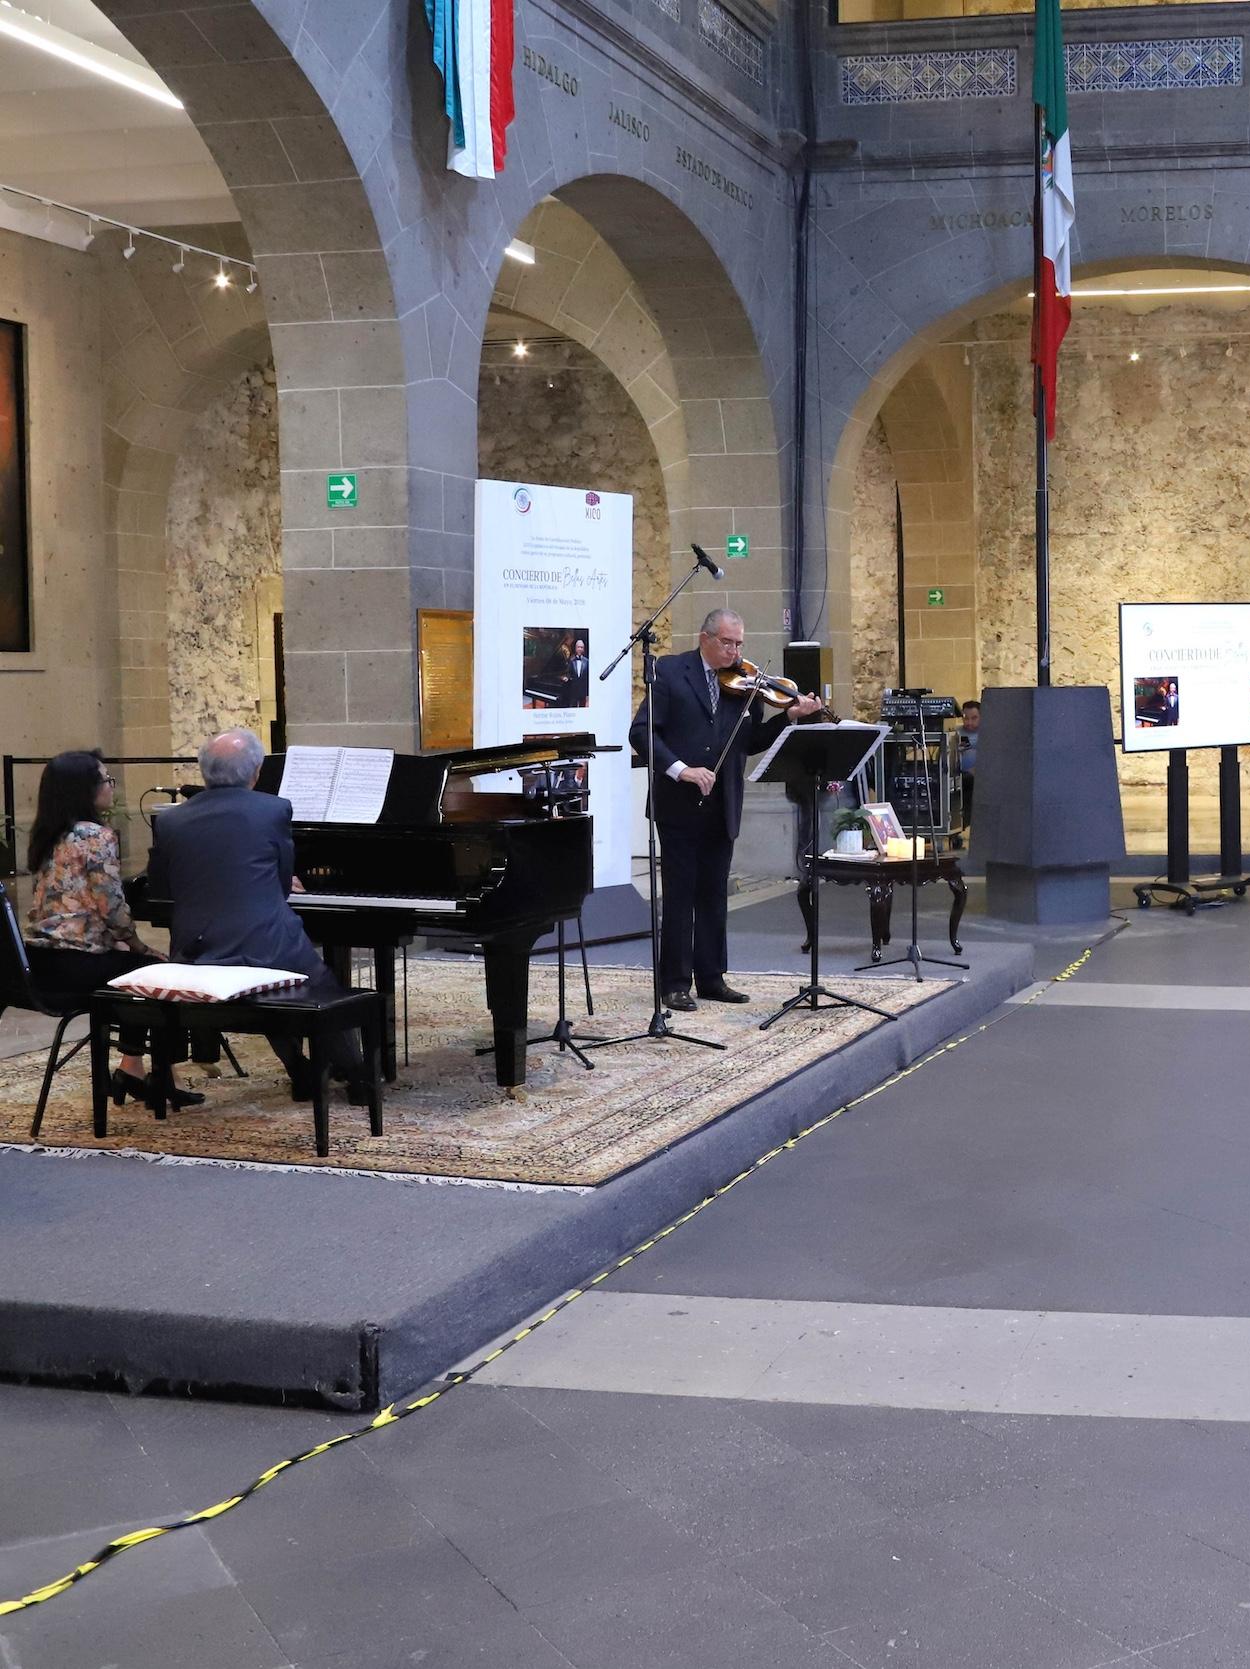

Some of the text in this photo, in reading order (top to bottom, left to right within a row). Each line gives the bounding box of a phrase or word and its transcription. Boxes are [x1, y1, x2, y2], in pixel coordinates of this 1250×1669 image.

[523, 46, 578, 97] HIDALGO
[608, 101, 650, 142] JALISCO
[930, 210, 1034, 231] MICHOACA
[1120, 204, 1213, 223] MORELOS
[585, 507, 601, 521] XICO
[503, 569, 550, 582] CONCIERTO
[551, 570, 562, 583] DE
[1148, 648, 1207, 662] CONCIERTO
